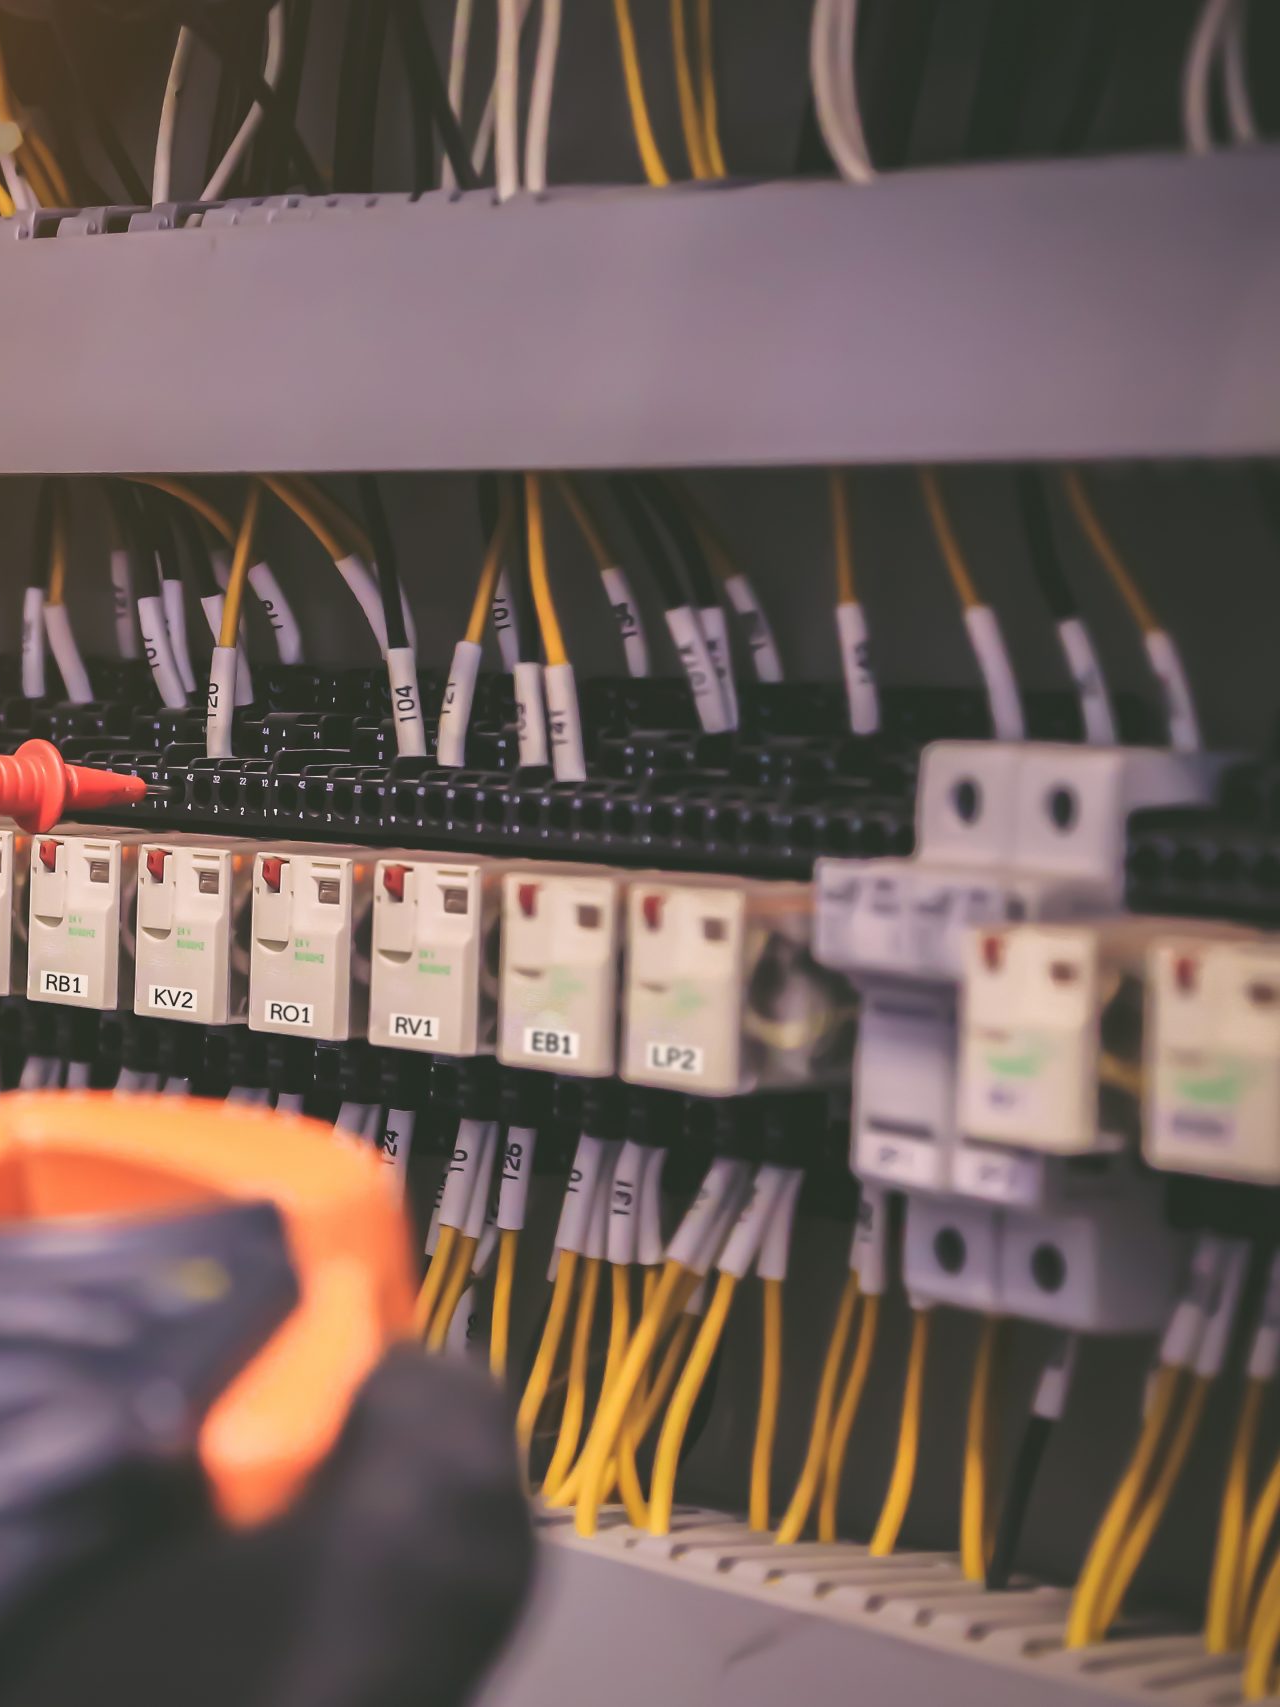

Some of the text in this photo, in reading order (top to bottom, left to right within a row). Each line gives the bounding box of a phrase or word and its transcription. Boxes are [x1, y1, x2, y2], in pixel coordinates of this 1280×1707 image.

[207, 683, 220, 716] 120
[395, 685, 417, 722] 104
[45, 973, 82, 994] RB1
[154, 988, 193, 1009] KV2
[270, 1003, 311, 1024] RO1
[395, 1016, 433, 1037] RV1
[531, 1031, 572, 1055] EB1
[651, 1046, 696, 1071] LP2
[502, 1143, 523, 1180] 126
